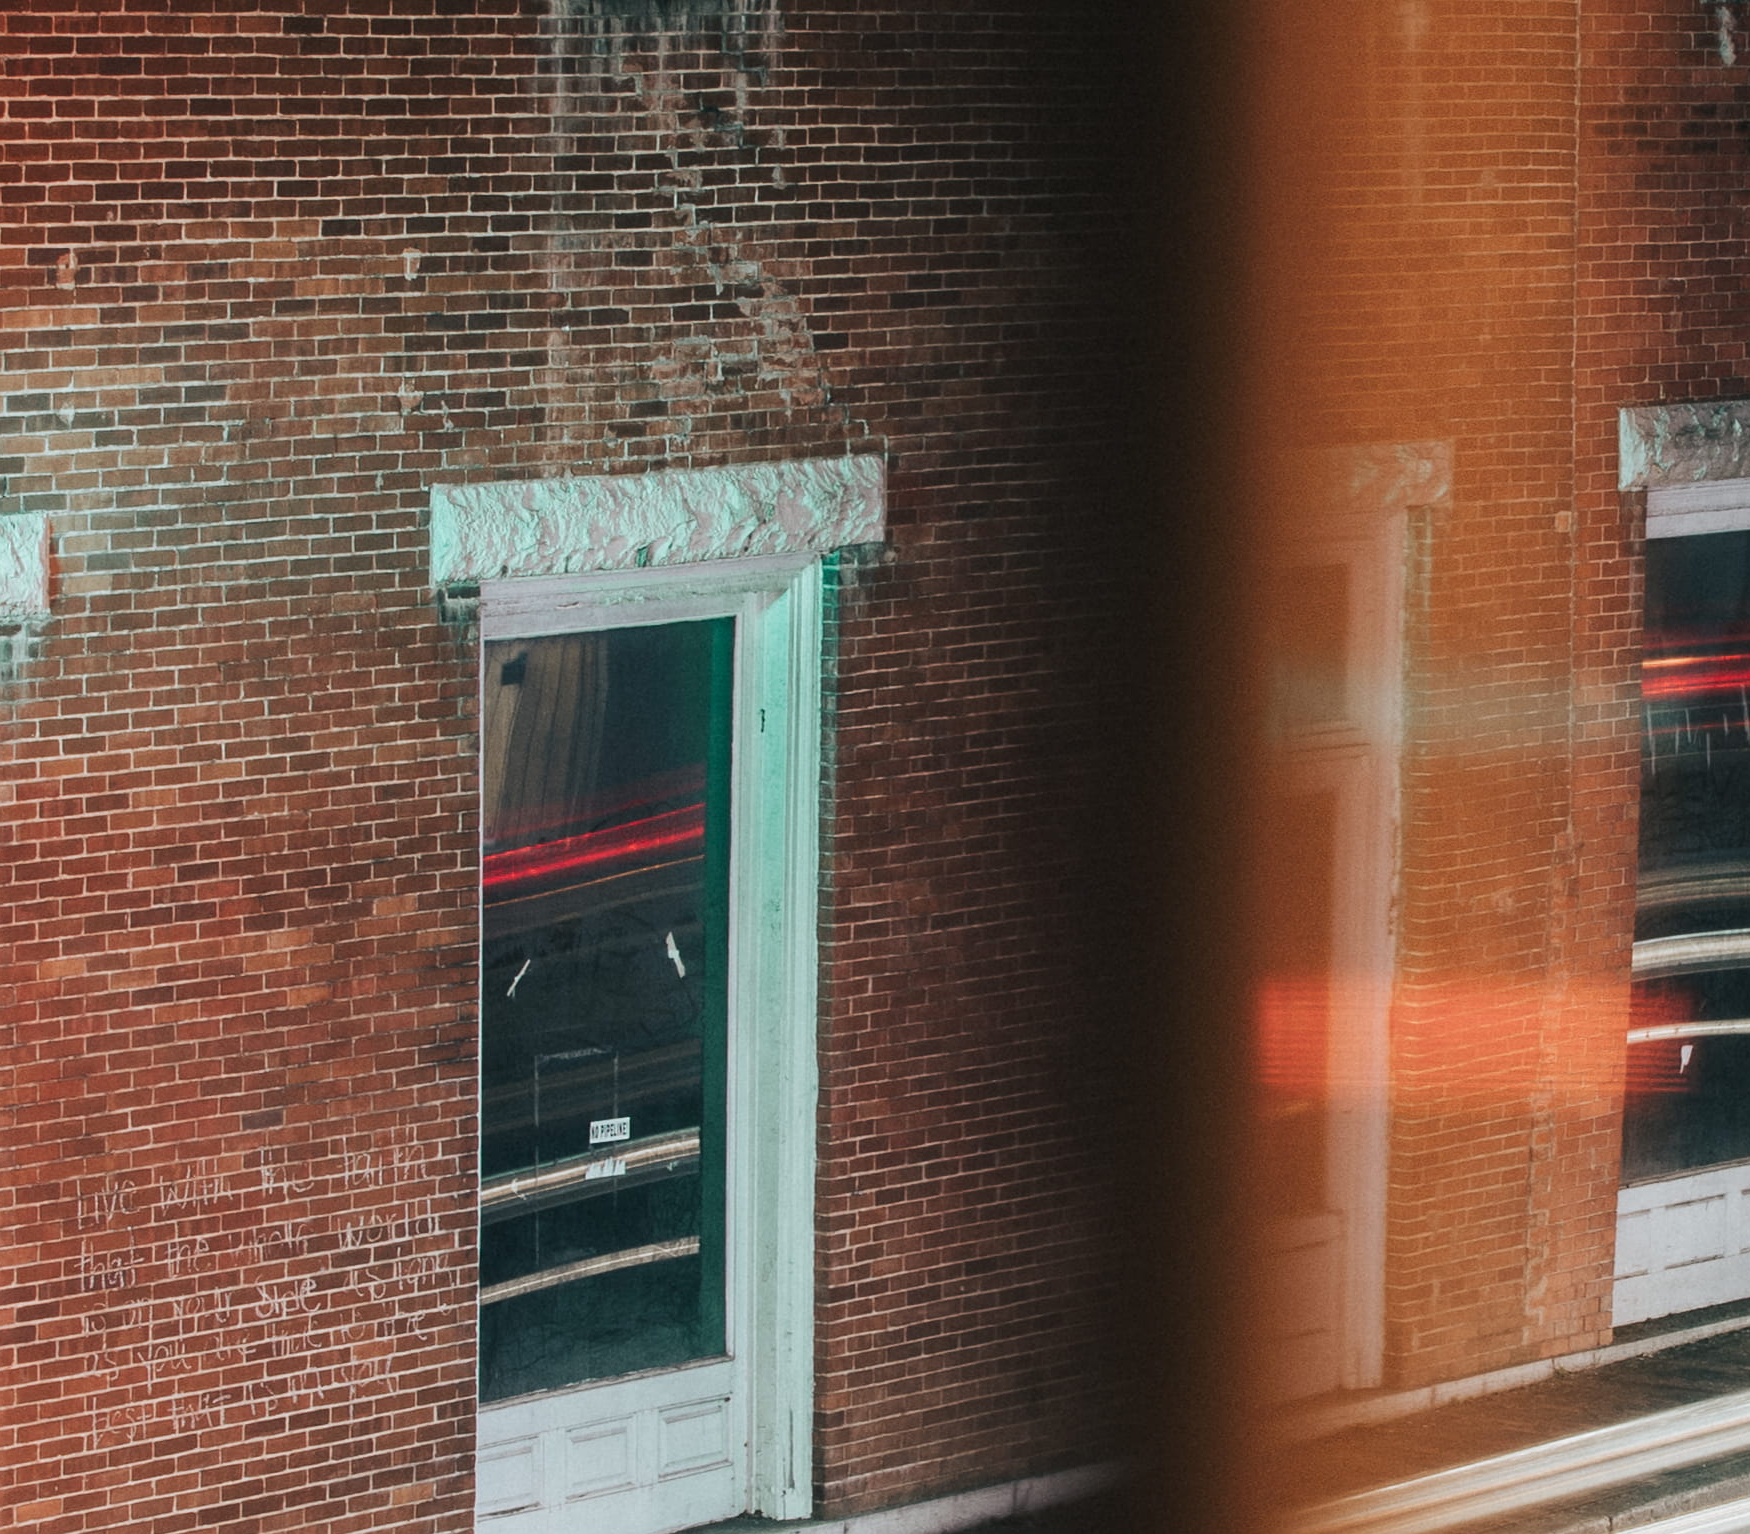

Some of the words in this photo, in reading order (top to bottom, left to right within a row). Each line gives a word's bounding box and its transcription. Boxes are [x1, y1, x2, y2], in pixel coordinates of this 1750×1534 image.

[159, 1158, 234, 1217] with
[260, 1146, 315, 1198] the
[74, 1227, 145, 1291] that
